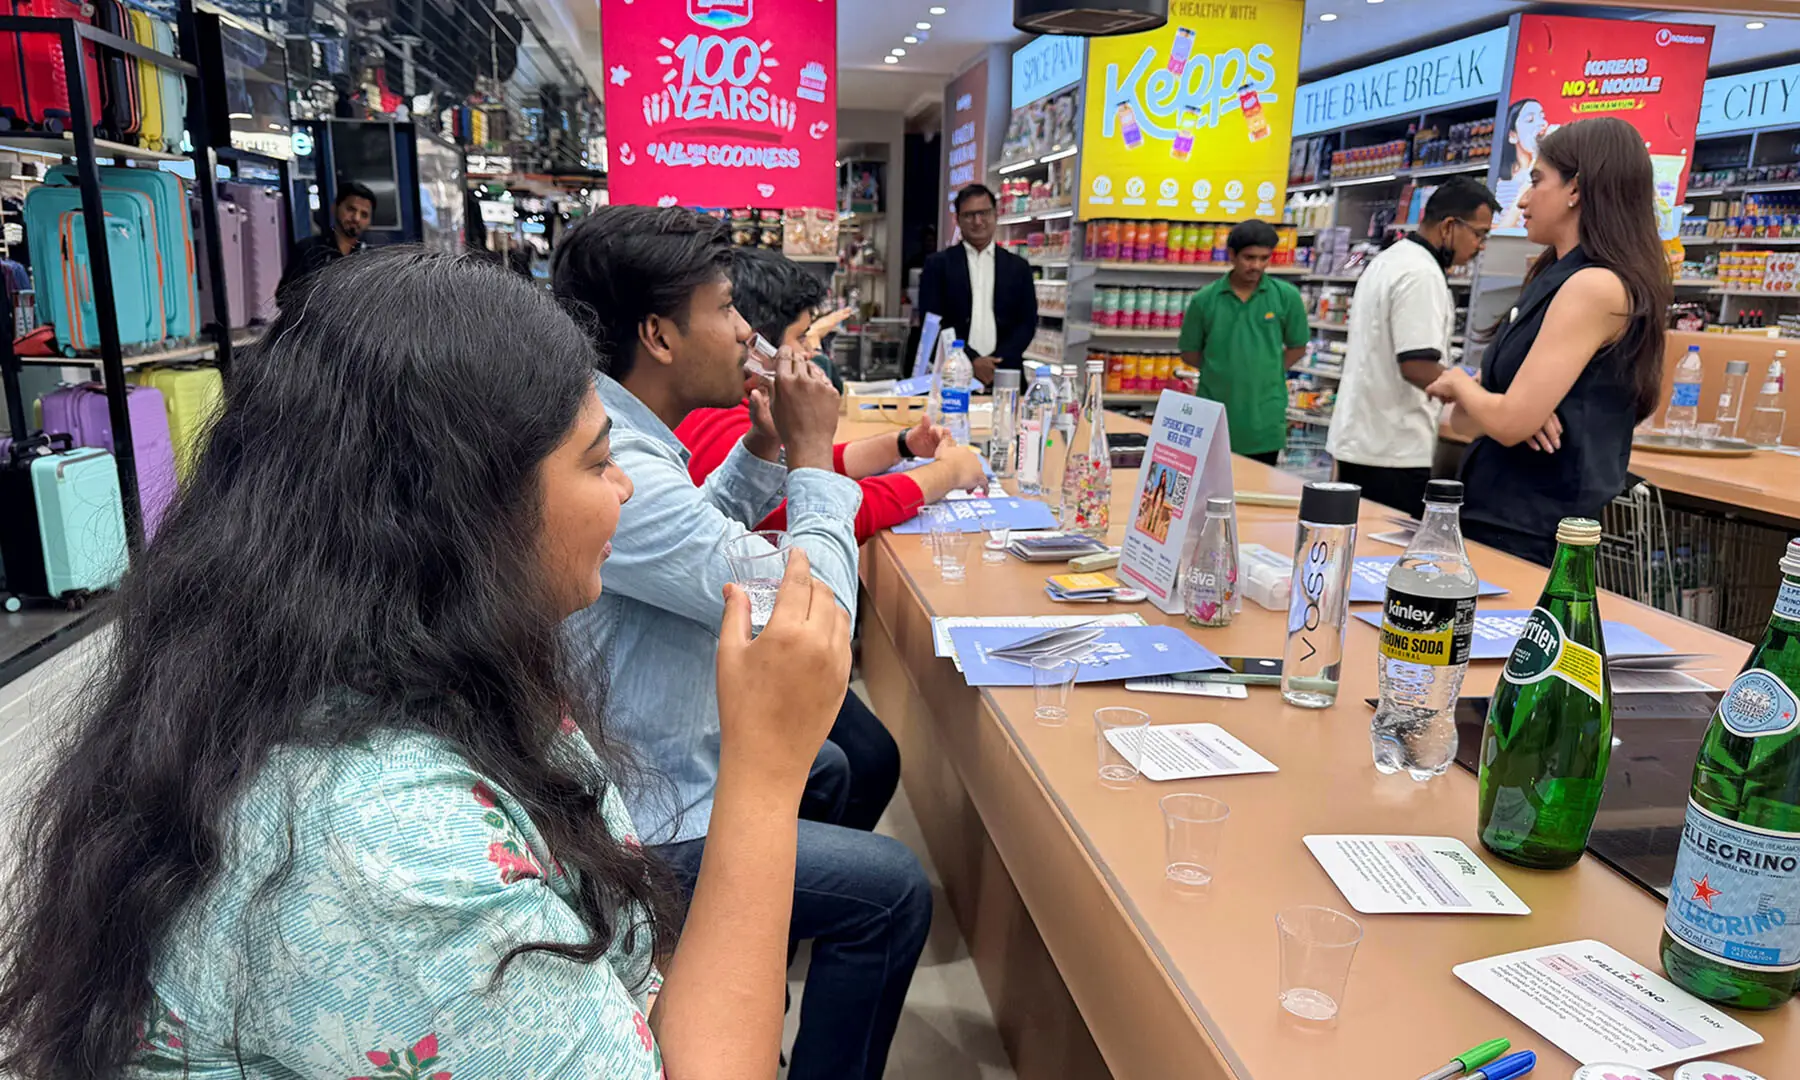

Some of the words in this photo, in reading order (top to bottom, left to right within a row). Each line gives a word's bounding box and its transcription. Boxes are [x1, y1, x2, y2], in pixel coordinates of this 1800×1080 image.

[1180, 5, 1224, 19] HEALTHY
[1229, 6, 1257, 21] WITH
[674, 34, 761, 86] 100
[1584, 58, 1648, 77] KOREA'S
[1304, 86, 1341, 125] THE
[1343, 70, 1399, 116] BAKE
[1404, 46, 1487, 103] BREAK
[1561, 80, 1586, 97] NO
[1601, 76, 1663, 95] NOODLE
[1724, 74, 1800, 121] CITY
[667, 84, 769, 121] YEARS
[706, 145, 800, 169] GOODNESS
[1300, 541, 1328, 662] VOSS
[1388, 599, 1434, 625] kinley
[1411, 638, 1444, 656] SODA
[1683, 820, 1797, 873] ELLEGRINO
[1706, 825, 1743, 844] PELLEGRINO
[1743, 836, 1765, 849] TERME
[1739, 869, 1759, 877] WATER
[1679, 924, 1692, 938] 750
[1699, 1013, 1724, 1030] Italy
